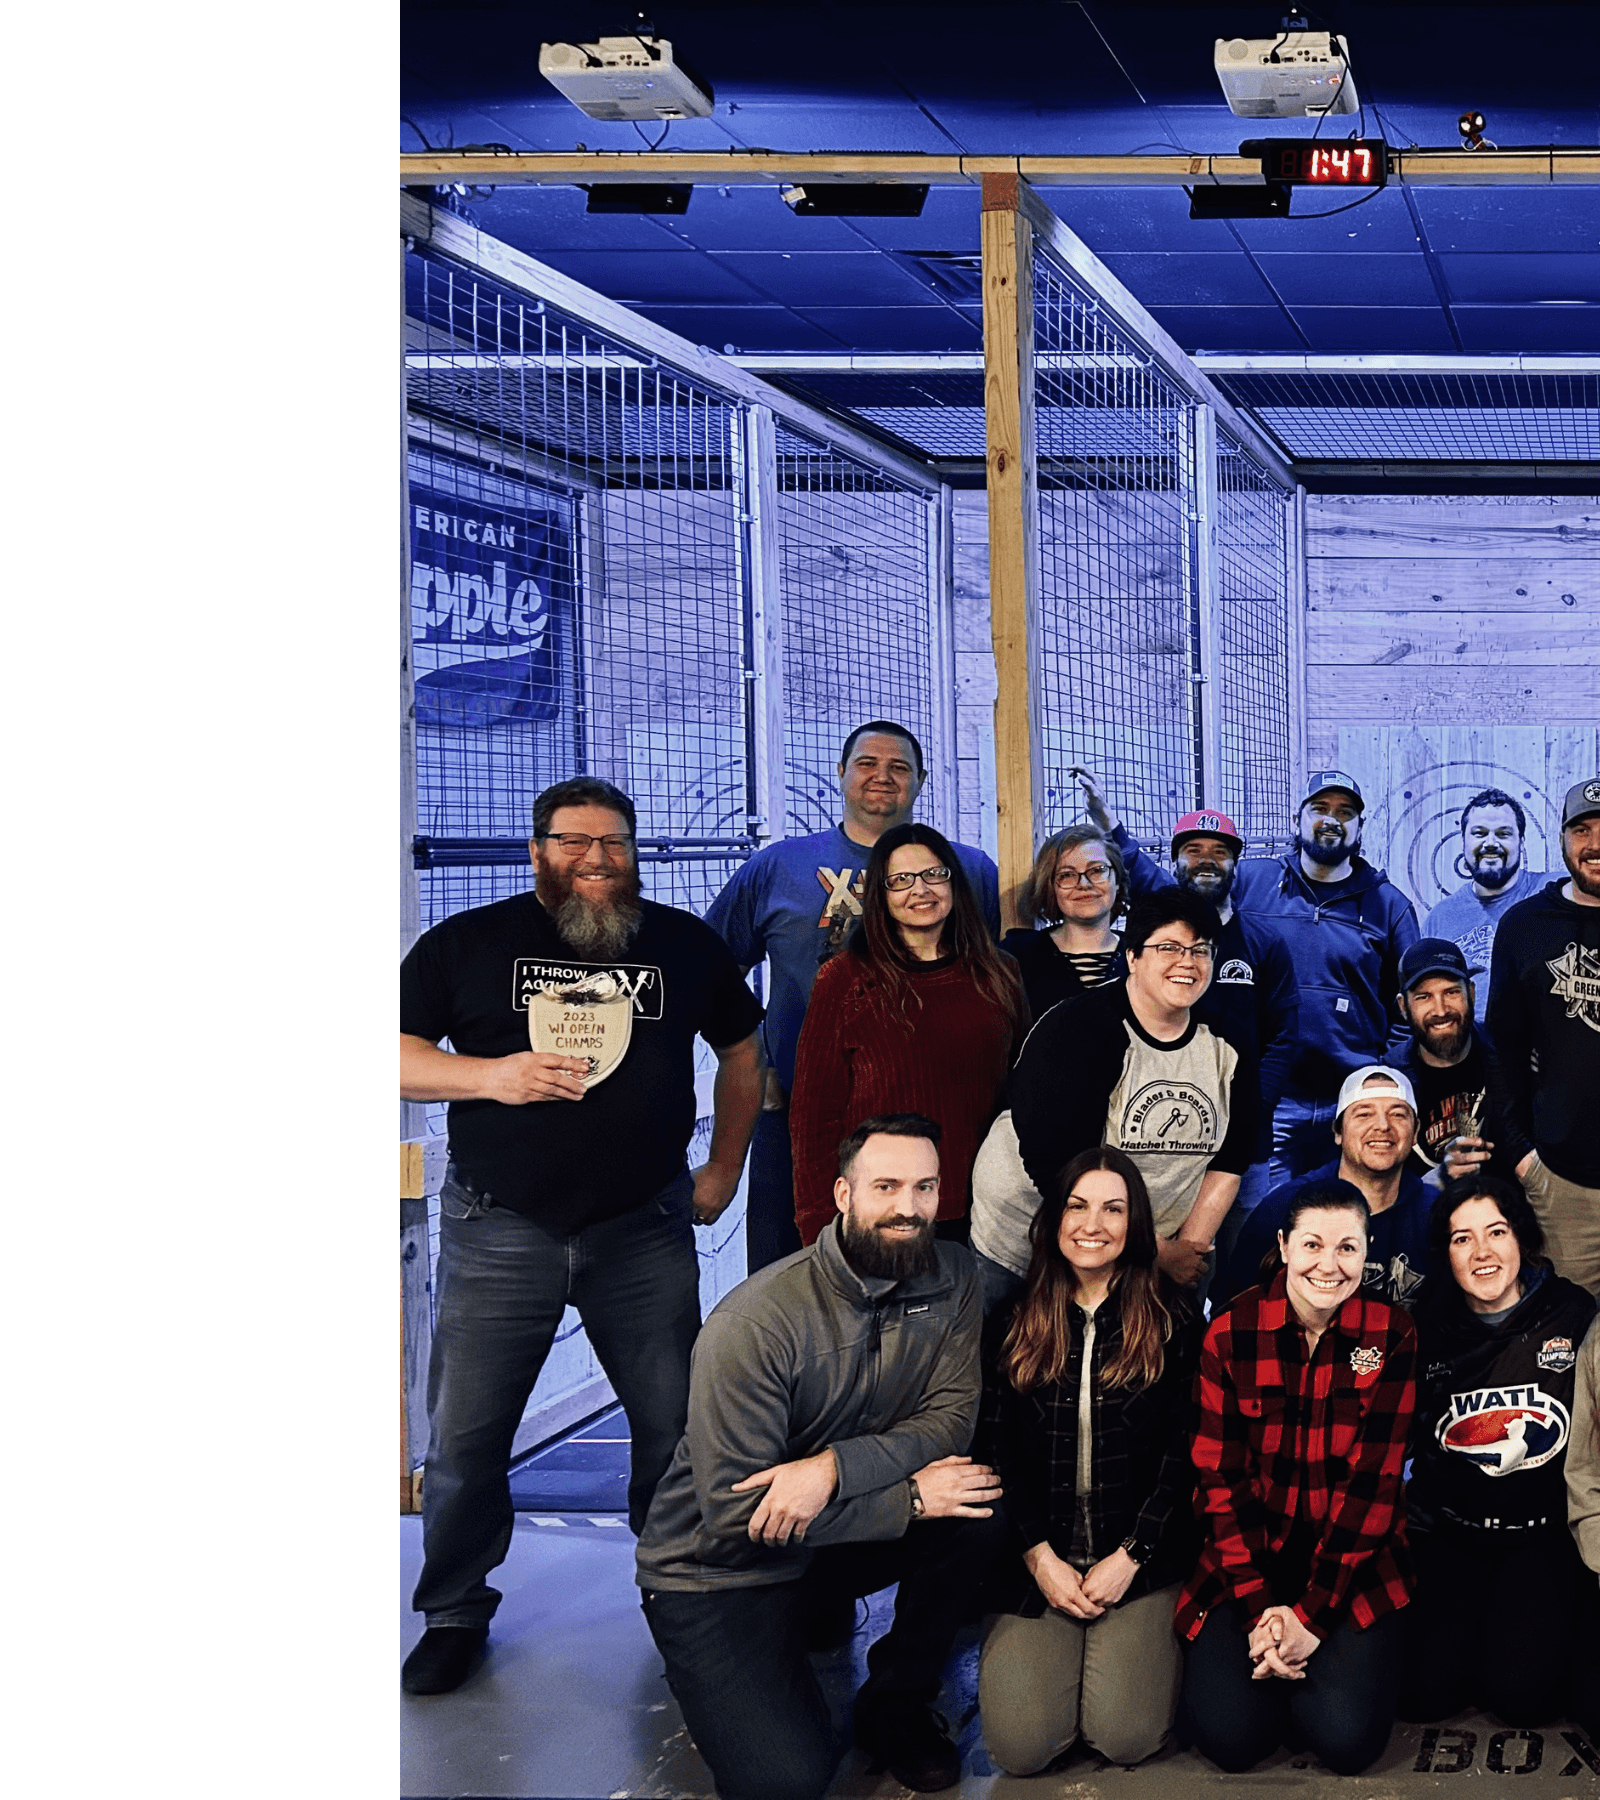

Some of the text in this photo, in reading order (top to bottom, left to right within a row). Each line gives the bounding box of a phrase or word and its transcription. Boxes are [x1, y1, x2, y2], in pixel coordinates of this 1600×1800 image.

[1311, 148, 1370, 177] 1:47
[523, 966, 587, 979] I THROW
[1574, 981, 1600, 997] GREEN
[563, 1012, 595, 1021] 2023
[548, 1024, 565, 1034] WI
[556, 1037, 603, 1049] CHAMPS
[1133, 1091, 1164, 1123] Blades
[1179, 1091, 1210, 1124] Boards
[1120, 1140, 1214, 1151] Hatchet Throwing
[1454, 1387, 1545, 1417] WATL
